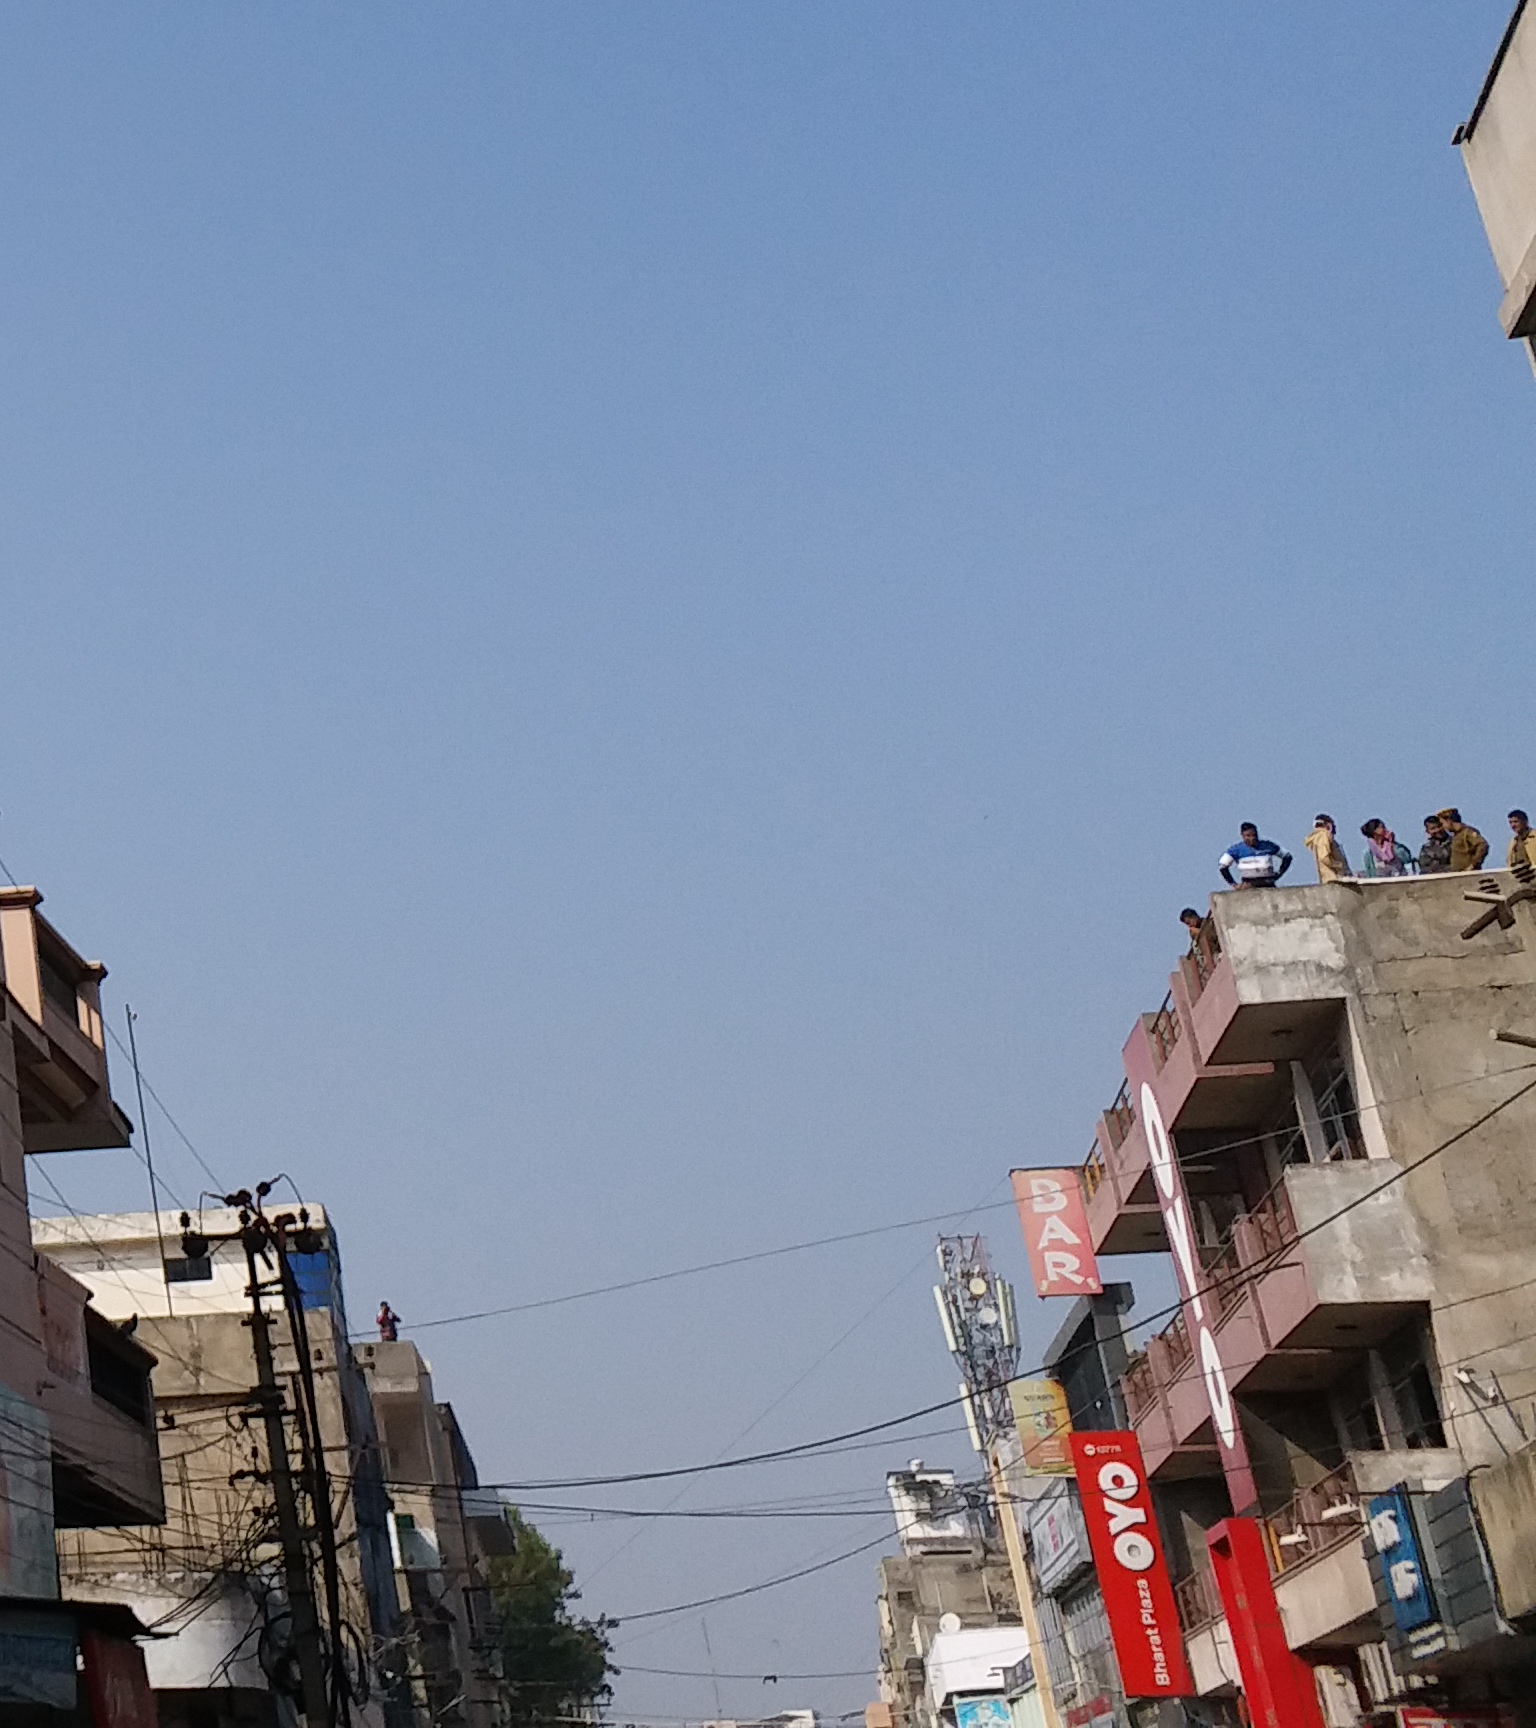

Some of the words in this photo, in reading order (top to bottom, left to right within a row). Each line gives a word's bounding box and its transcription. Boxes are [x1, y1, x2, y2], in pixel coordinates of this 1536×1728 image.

[1029, 1178, 1085, 1285] BAR
[1097, 1460, 1155, 1571] OYO
[1136, 1578, 1156, 1625] Plaza
[1144, 1627, 1171, 1687] Bharat
